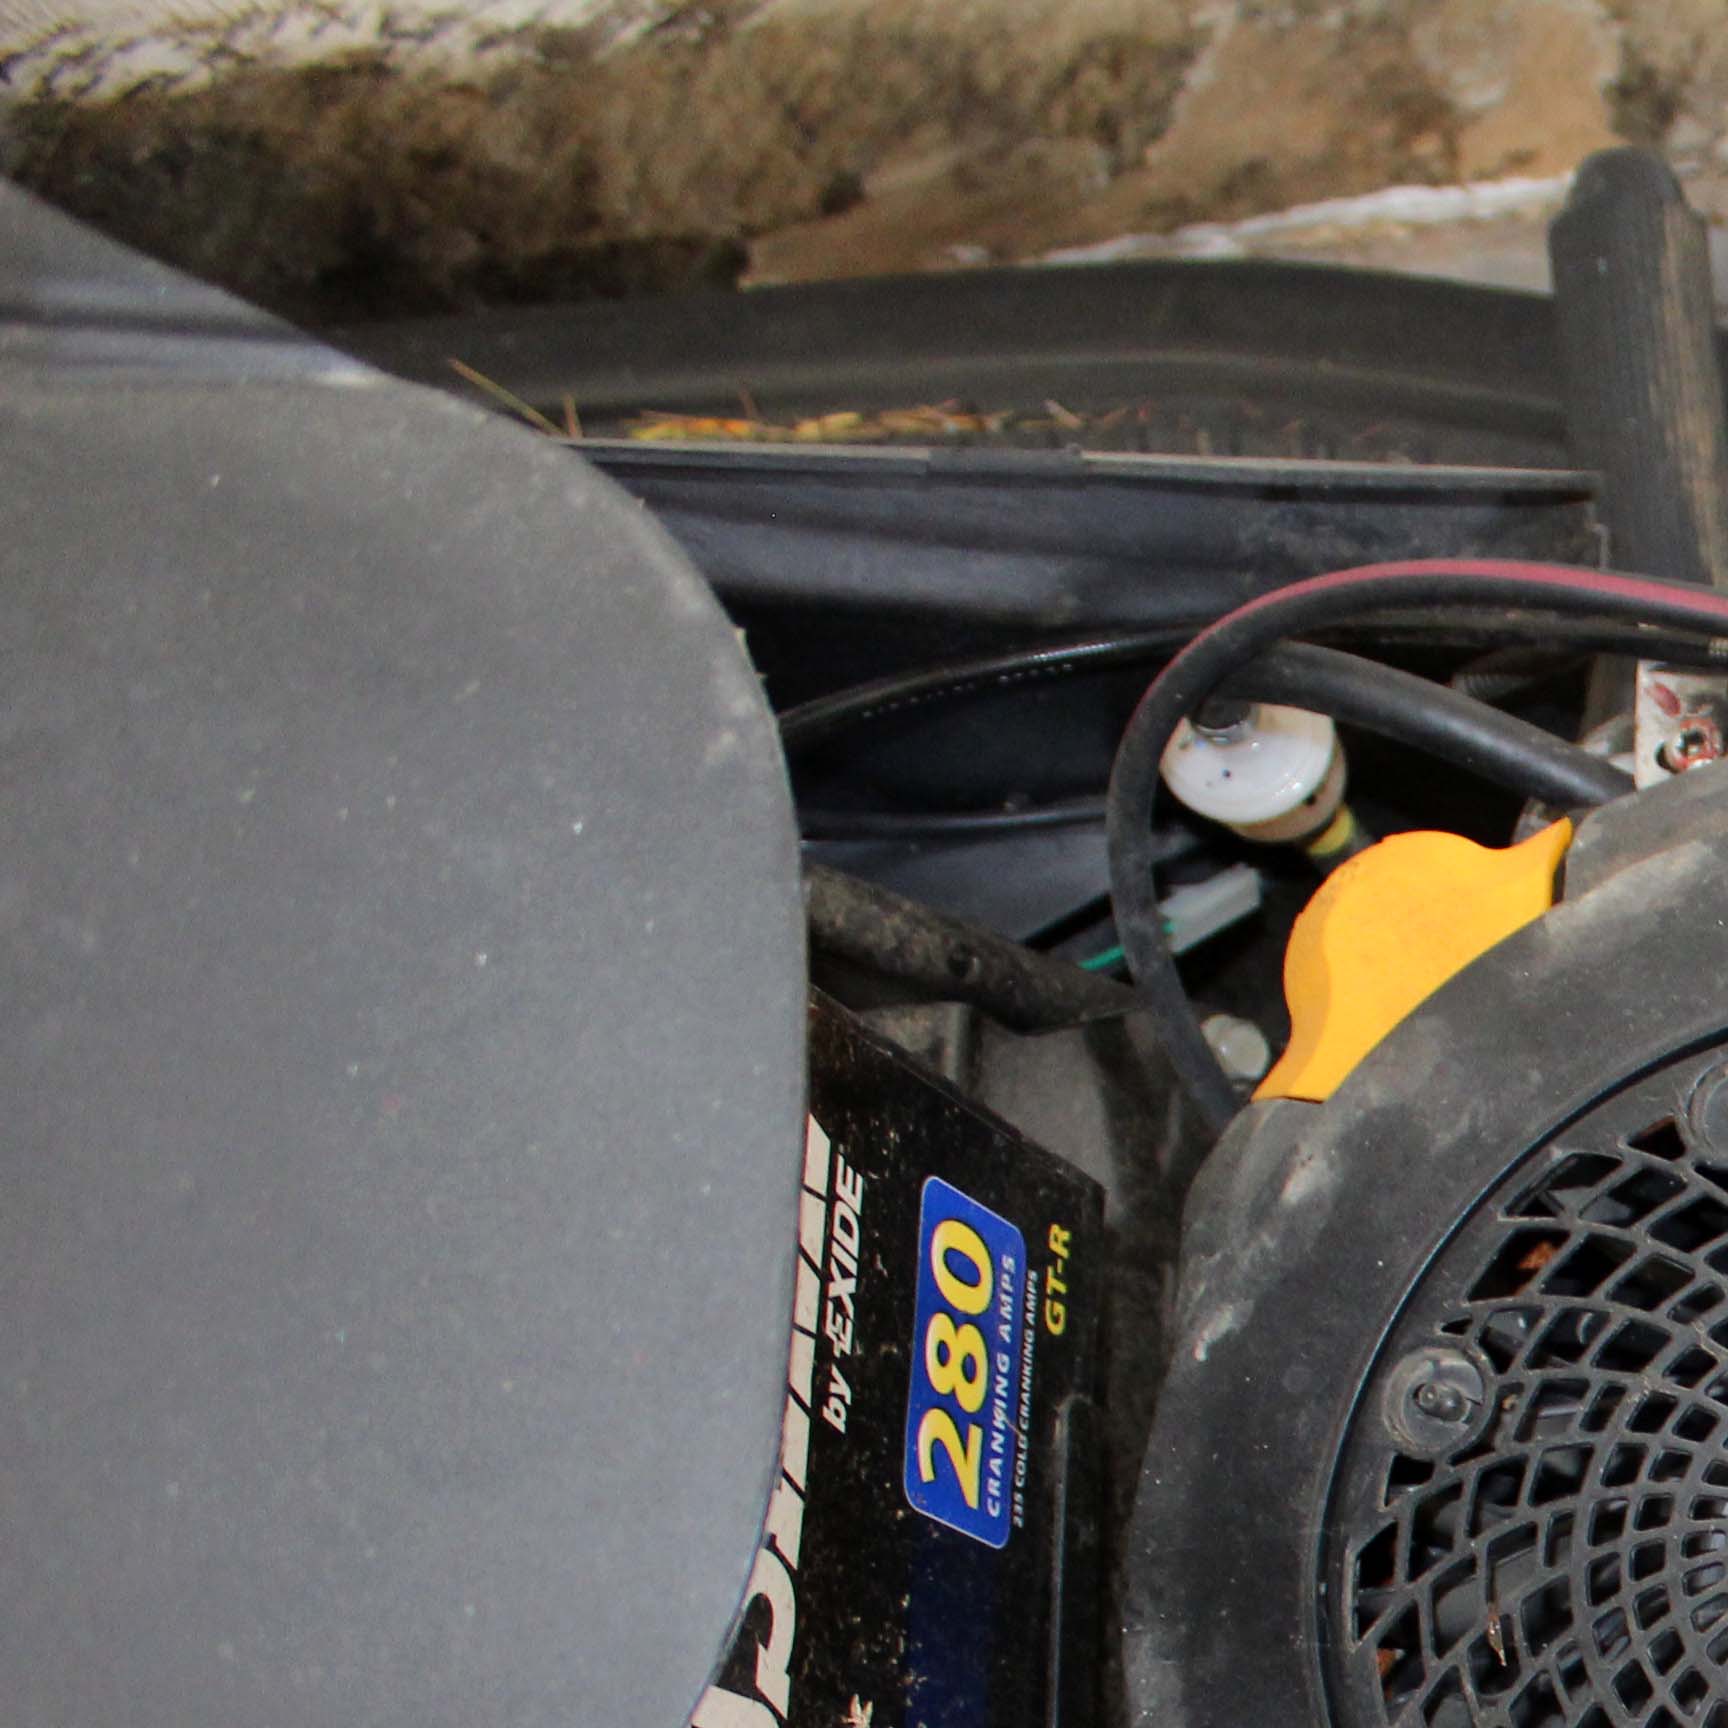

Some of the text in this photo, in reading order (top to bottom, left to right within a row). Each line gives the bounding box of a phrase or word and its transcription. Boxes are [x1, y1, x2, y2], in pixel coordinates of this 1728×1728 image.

[822, 1151, 864, 1433] by EXIDE
[1025, 1270, 1039, 1326] AMPS
[1044, 1224, 1071, 1336] GT-R
[918, 1219, 995, 1509] 280
[987, 1254, 1017, 1518] CRANKING AMPS
[1018, 1330, 1035, 1431] CRANKING
[1015, 1433, 1029, 1487] COLD
